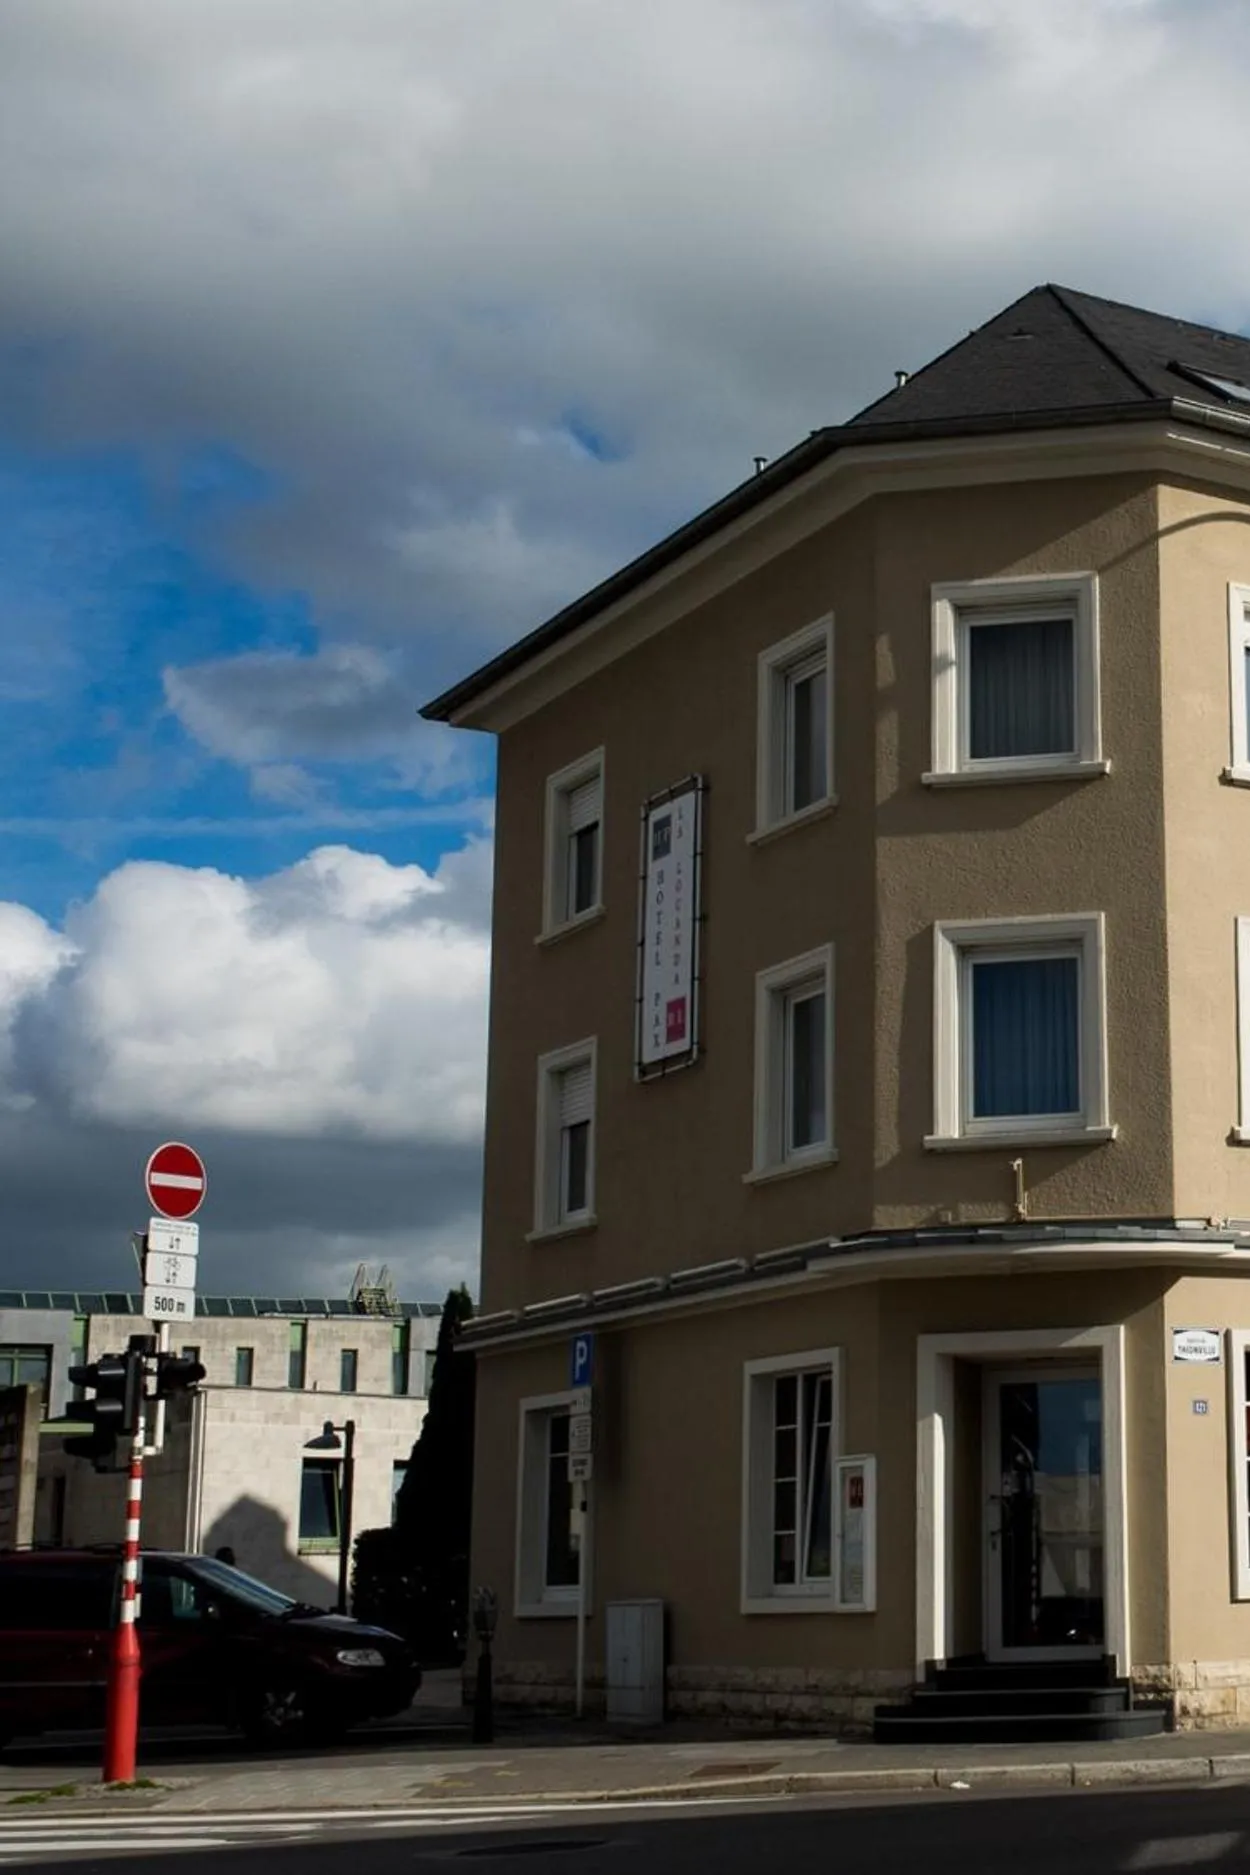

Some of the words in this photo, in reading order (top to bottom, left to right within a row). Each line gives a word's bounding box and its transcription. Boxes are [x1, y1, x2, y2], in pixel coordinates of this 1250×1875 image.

[655, 868, 665, 967] HOTEL
[154, 1296, 174, 1312] 500
[177, 1302, 185, 1313] m
[575, 1340, 587, 1380] P
